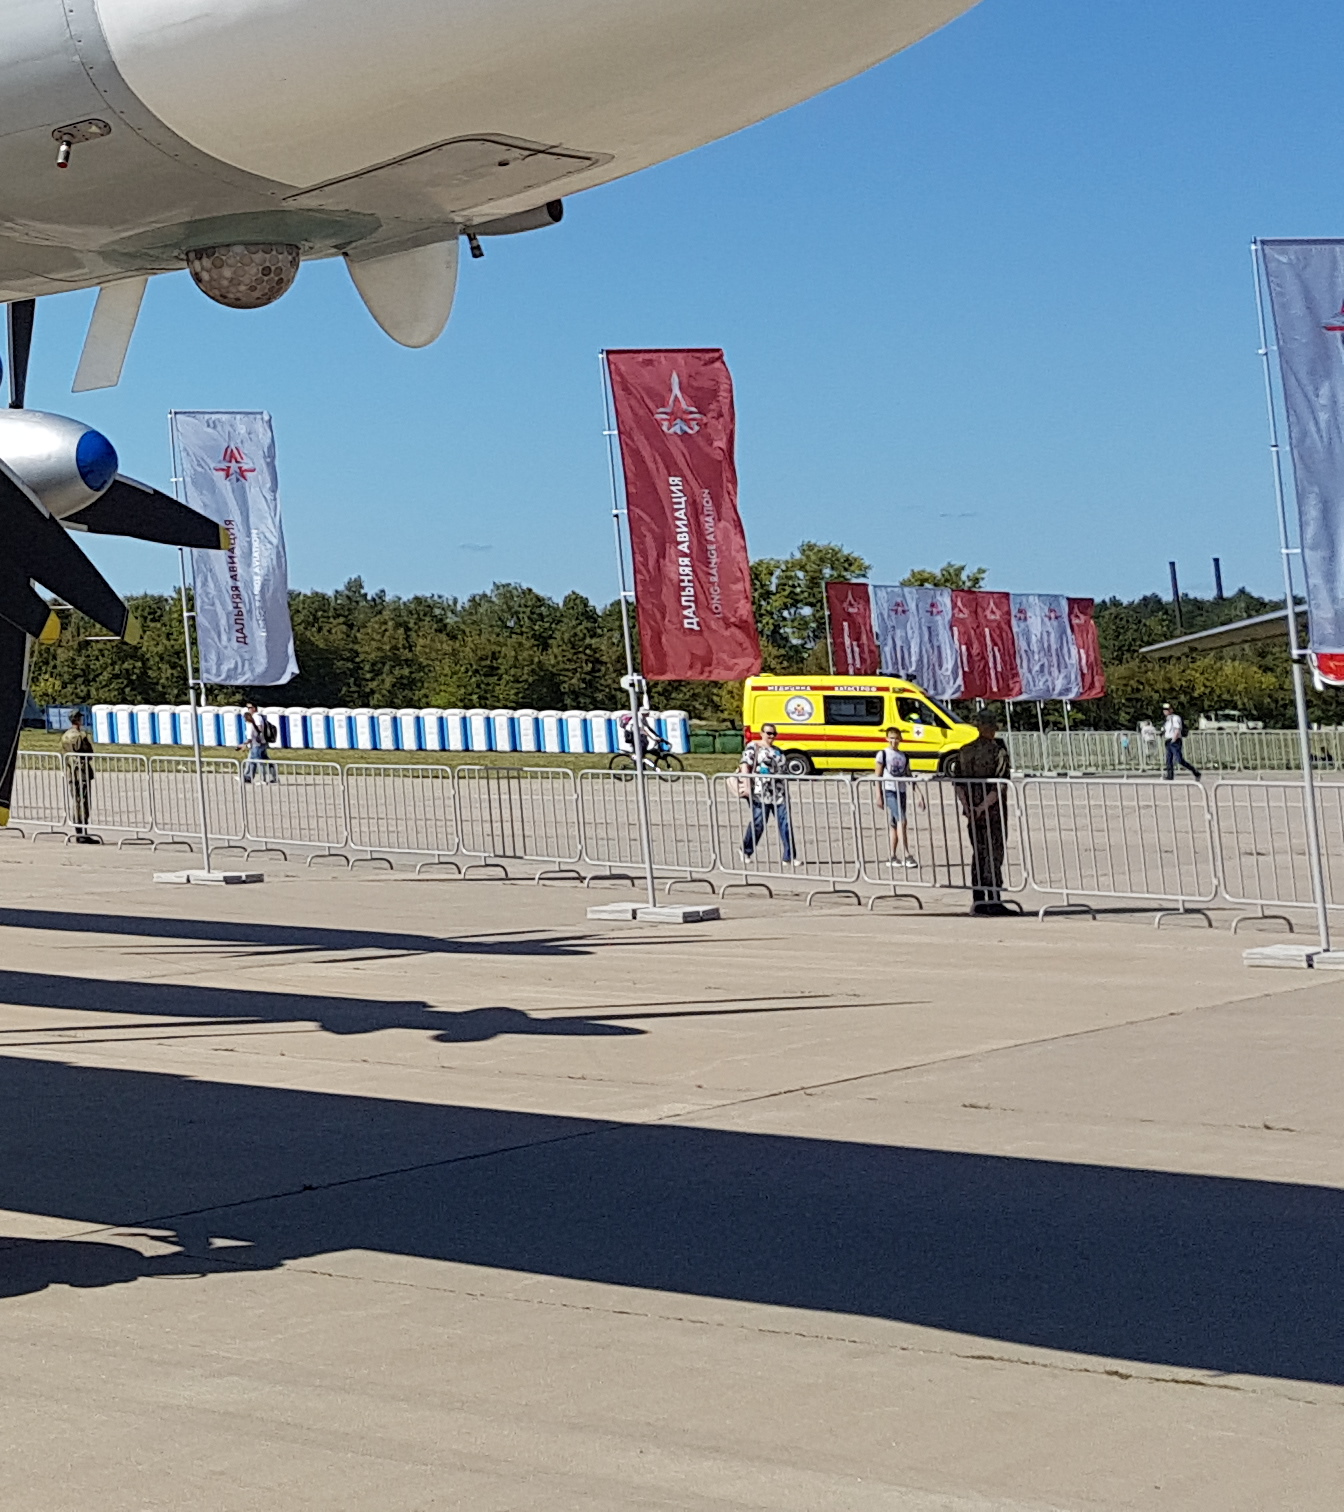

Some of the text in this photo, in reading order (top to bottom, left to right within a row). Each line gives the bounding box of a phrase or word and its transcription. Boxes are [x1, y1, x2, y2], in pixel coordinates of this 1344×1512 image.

[702, 488, 716, 542] AVIATION
[668, 476, 701, 631] ДАЛЬНЯЯ АВИАЦИЯ
[229, 585, 249, 645] ДАЛЬНЯЯ
